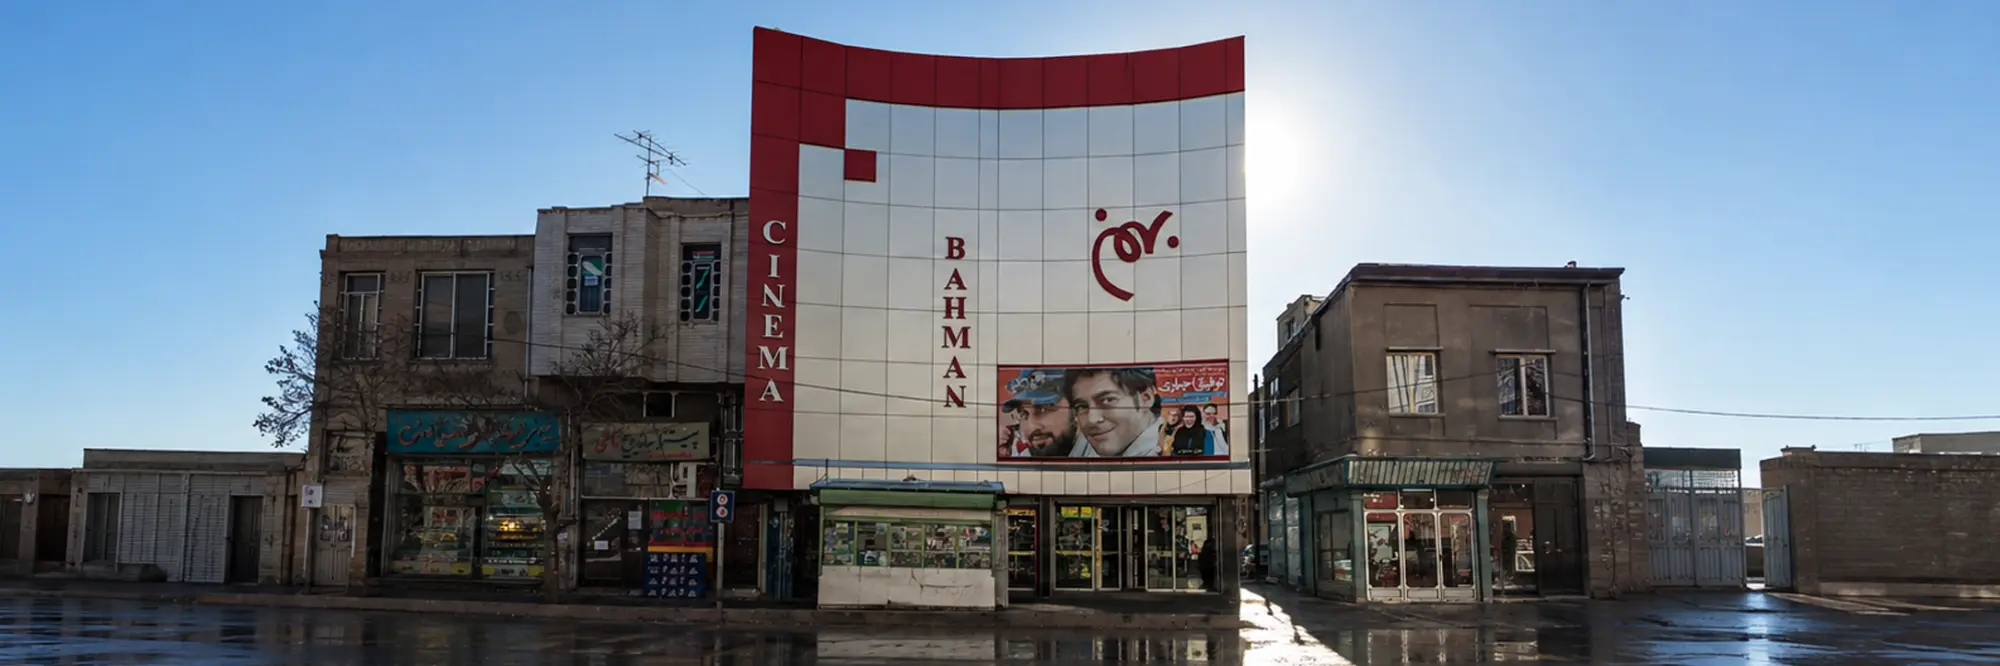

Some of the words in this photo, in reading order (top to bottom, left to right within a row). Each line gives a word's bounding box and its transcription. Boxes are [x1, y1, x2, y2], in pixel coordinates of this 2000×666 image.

[758, 219, 789, 402] CINEMA
[941, 236, 971, 408] BAHMAN
[1092, 208, 1179, 301] بهمن
